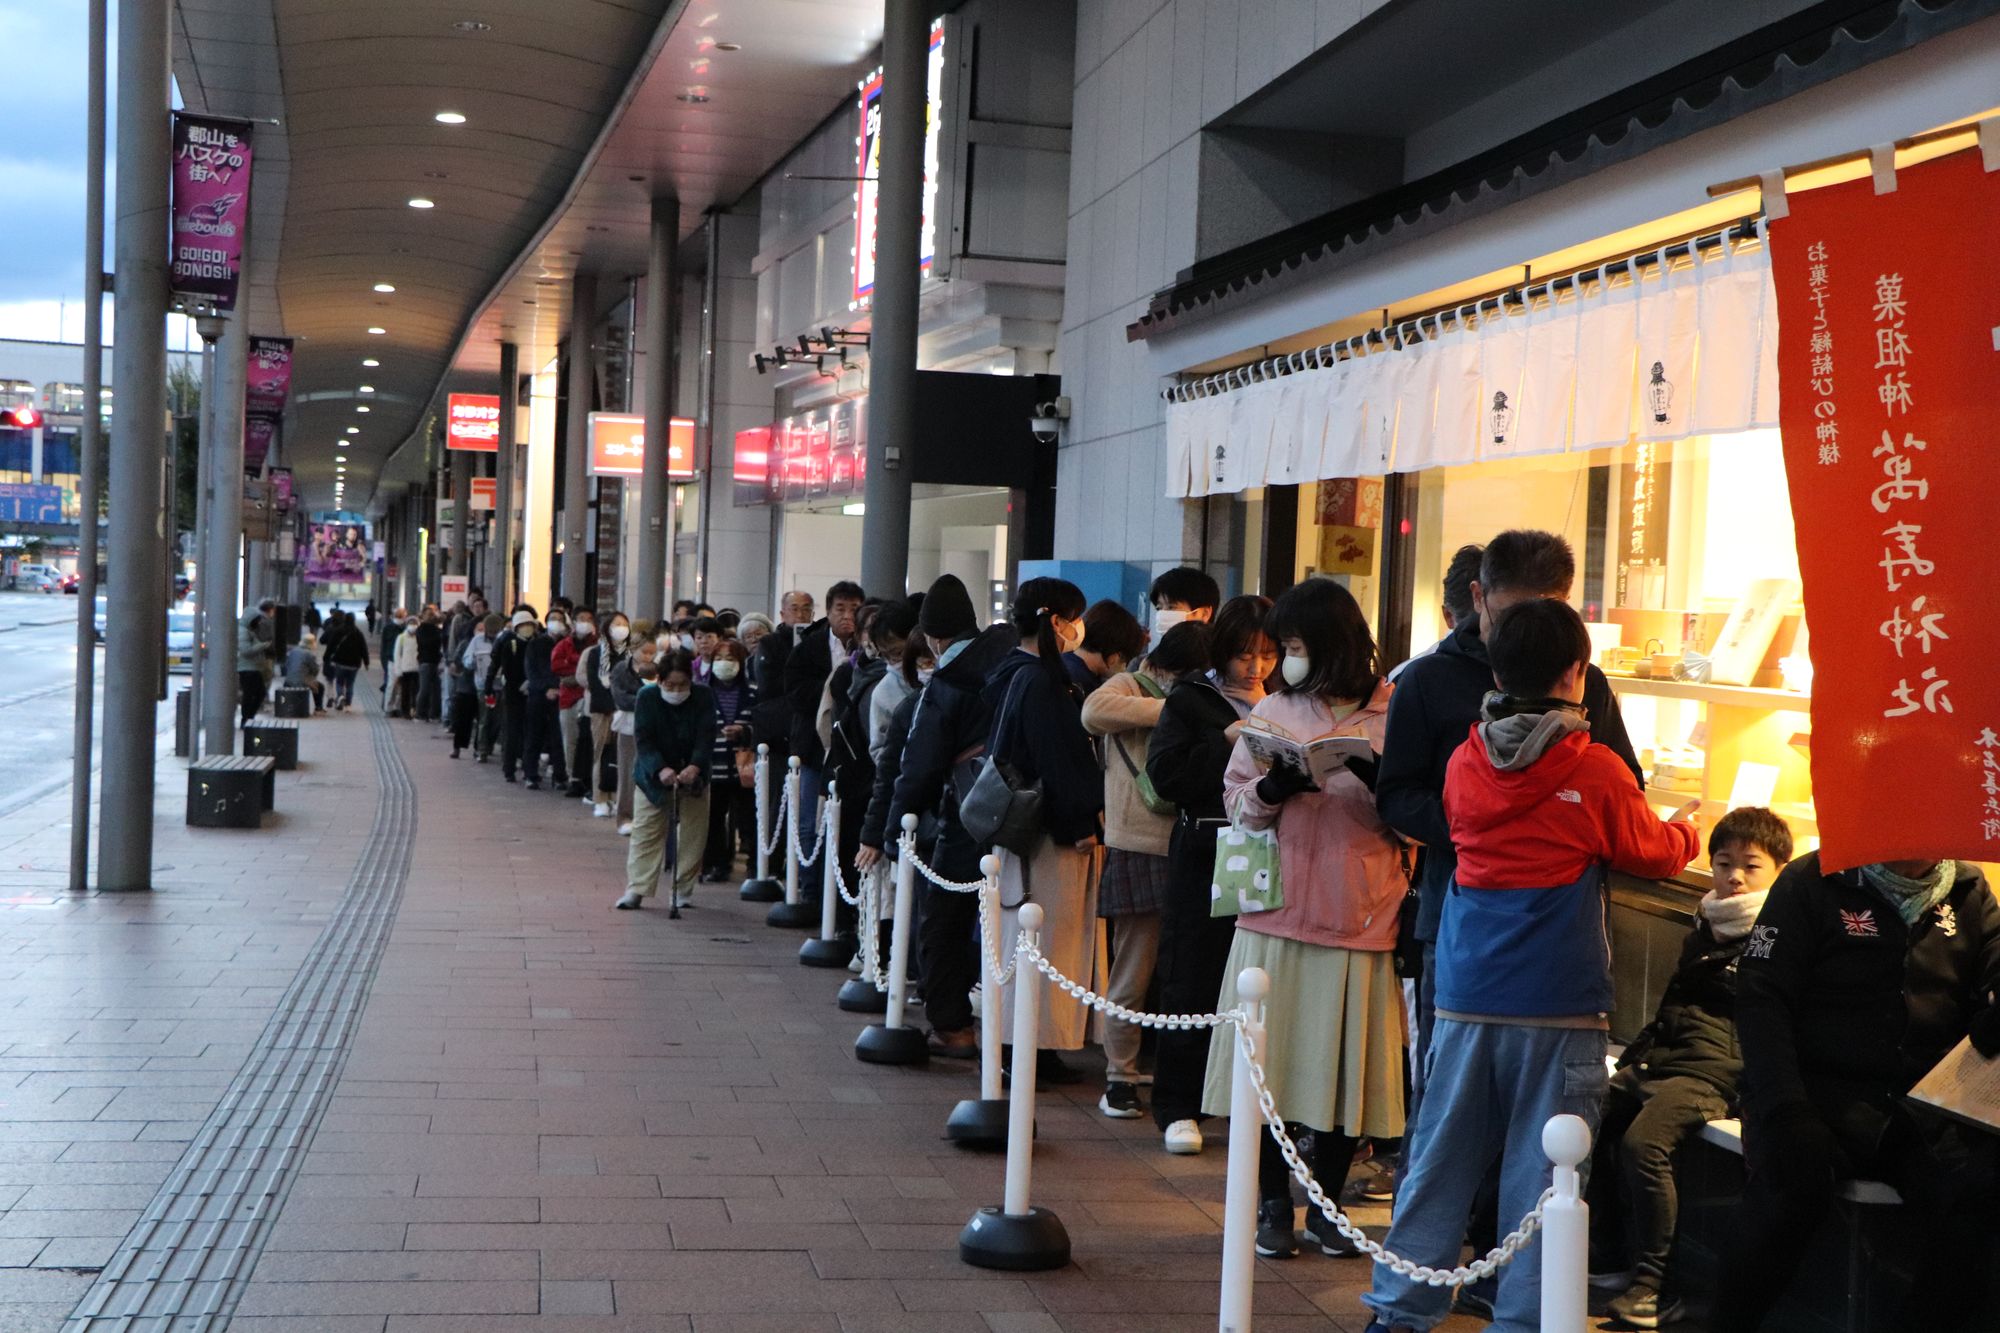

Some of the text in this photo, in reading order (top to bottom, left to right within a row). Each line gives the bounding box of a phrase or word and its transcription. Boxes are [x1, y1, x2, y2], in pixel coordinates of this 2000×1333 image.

[188, 126, 239, 148] 郡山を
[180, 144, 243, 168] バスケの
[180, 247, 227, 264] GO!GO!
[174, 261, 232, 280] BONDS!!
